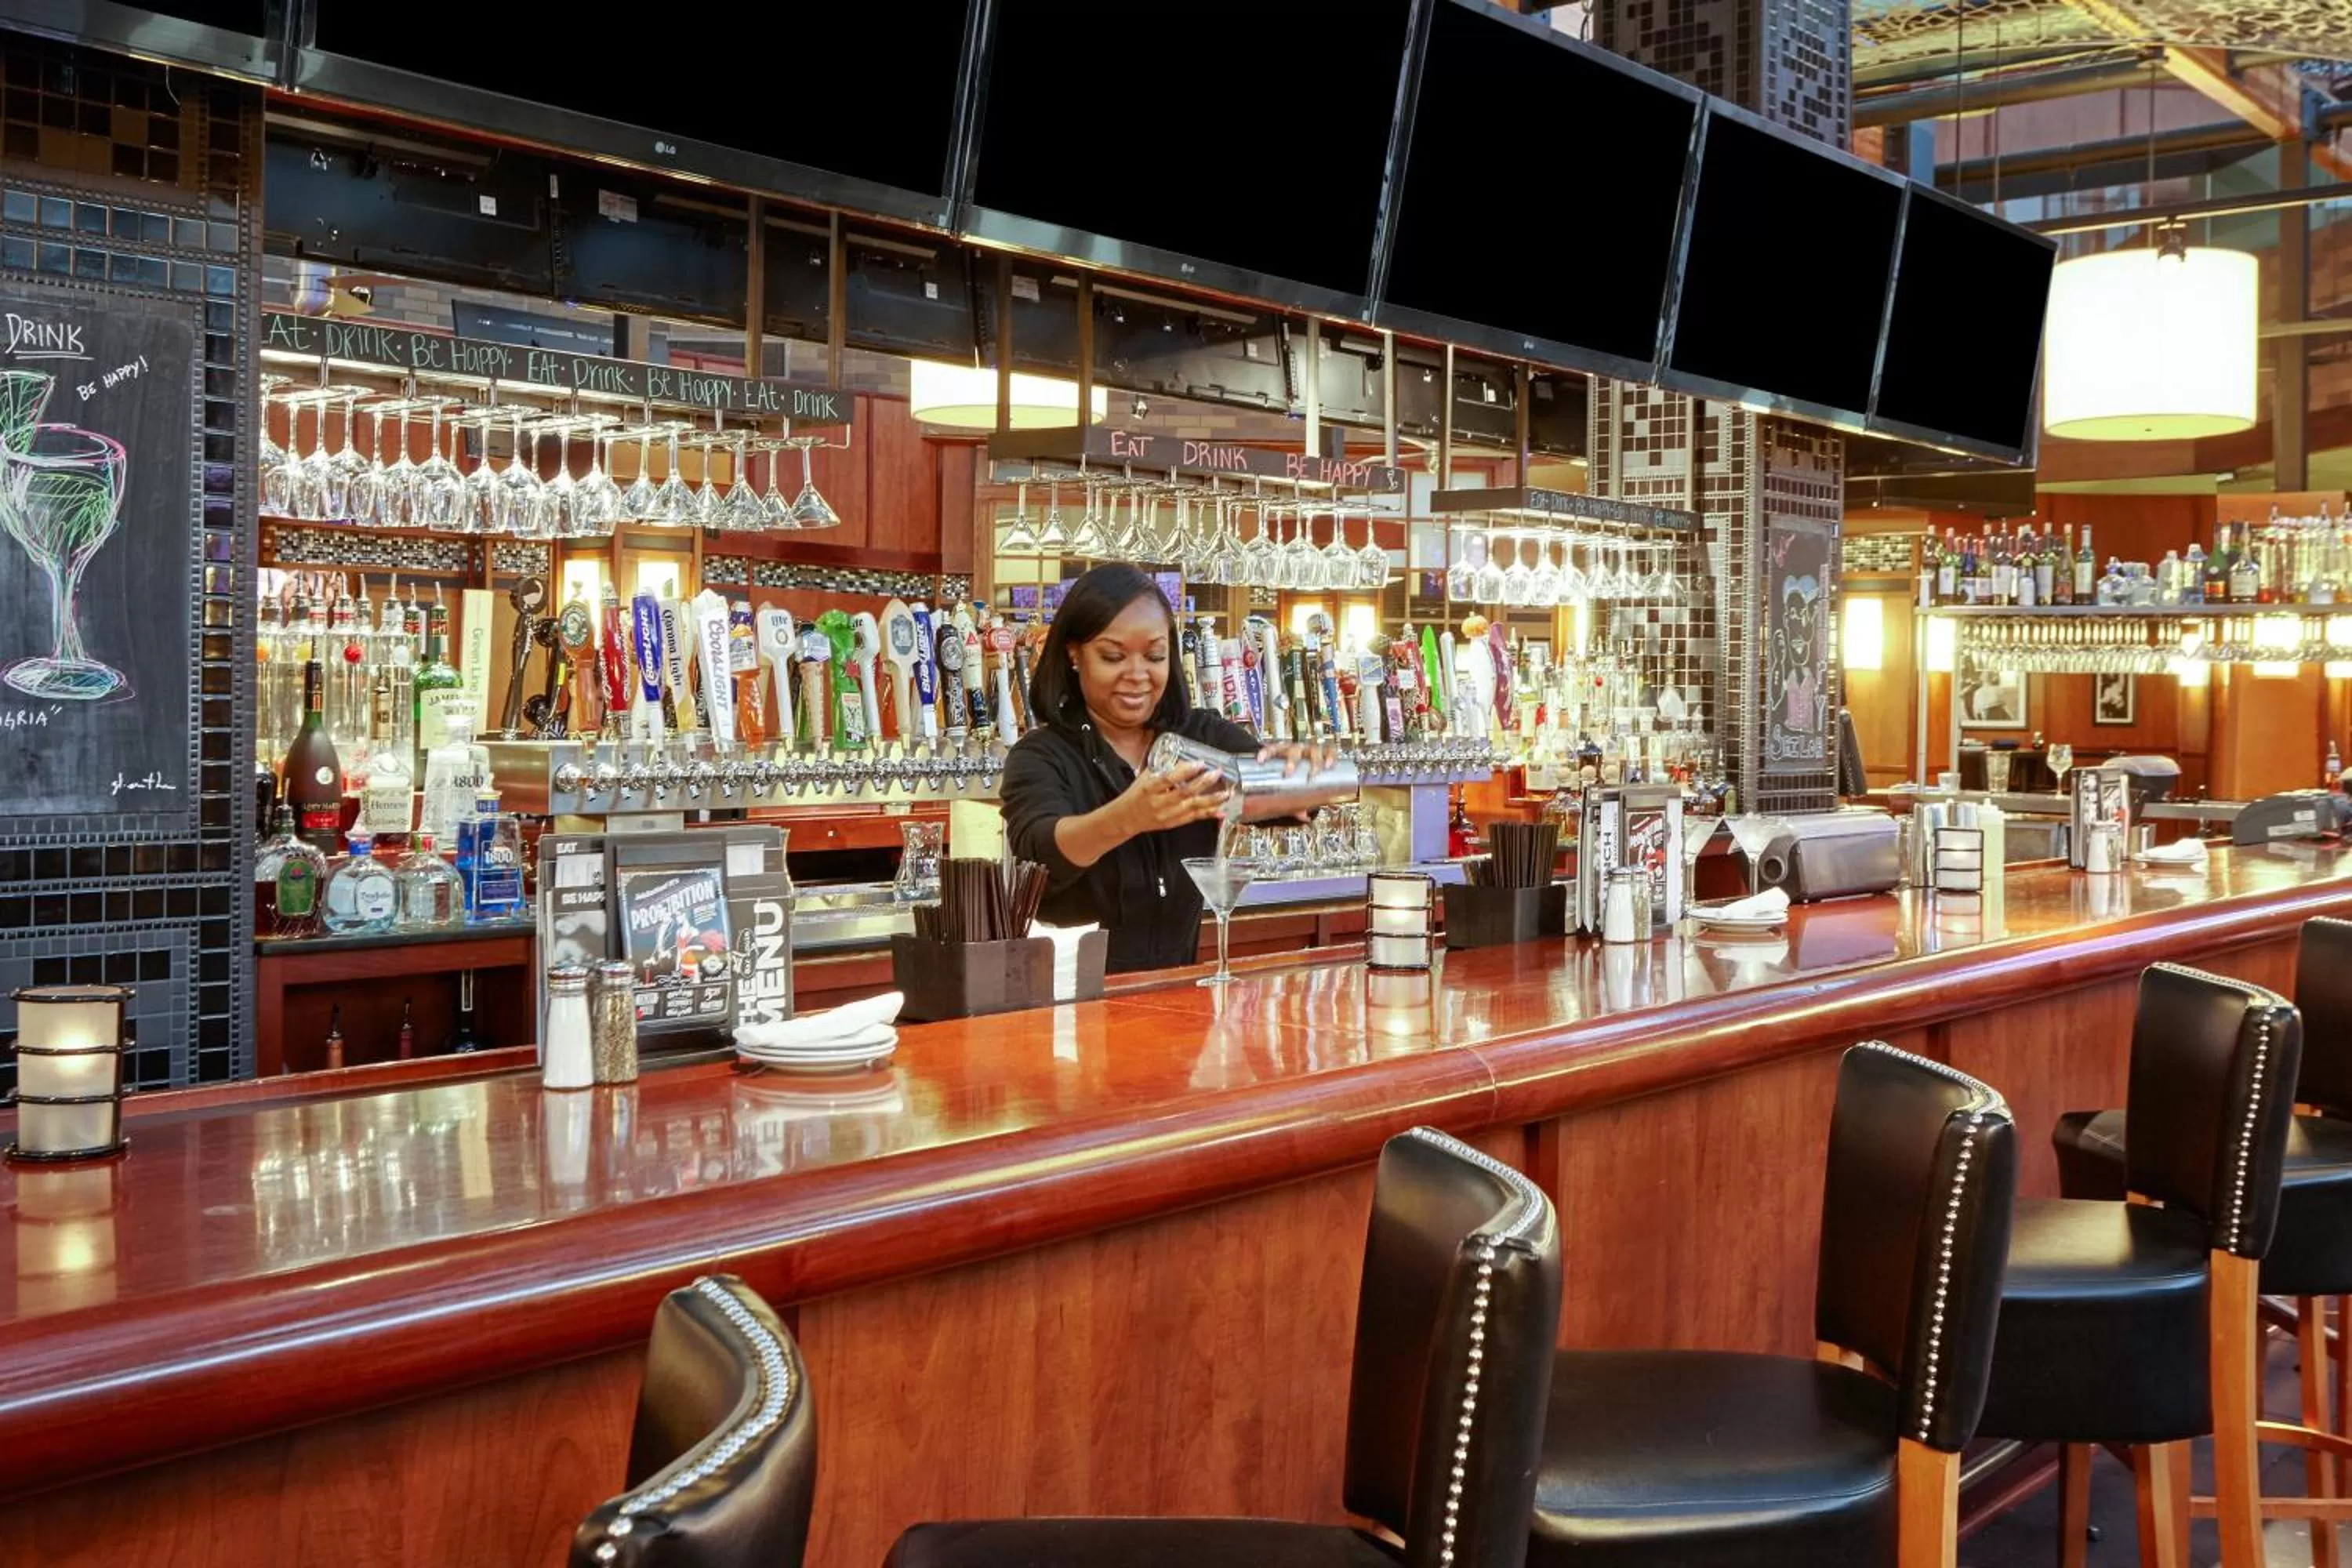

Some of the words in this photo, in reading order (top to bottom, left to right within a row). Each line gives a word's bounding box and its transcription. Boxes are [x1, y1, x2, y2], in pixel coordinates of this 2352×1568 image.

[5, 314, 84, 354] DRINK
[261, 312, 311, 350] At
[76, 383, 96, 401] BE
[103, 354, 149, 389] HAPPY!
[1110, 430, 1155, 458] EAT
[1183, 441, 1247, 470] DRINK
[1286, 452, 1308, 479] BE
[1319, 459, 1372, 487] HAPPY
[0, 704, 63, 731] GRIA"
[484, 851, 514, 864] 1800
[753, 902, 786, 1025] MENU
